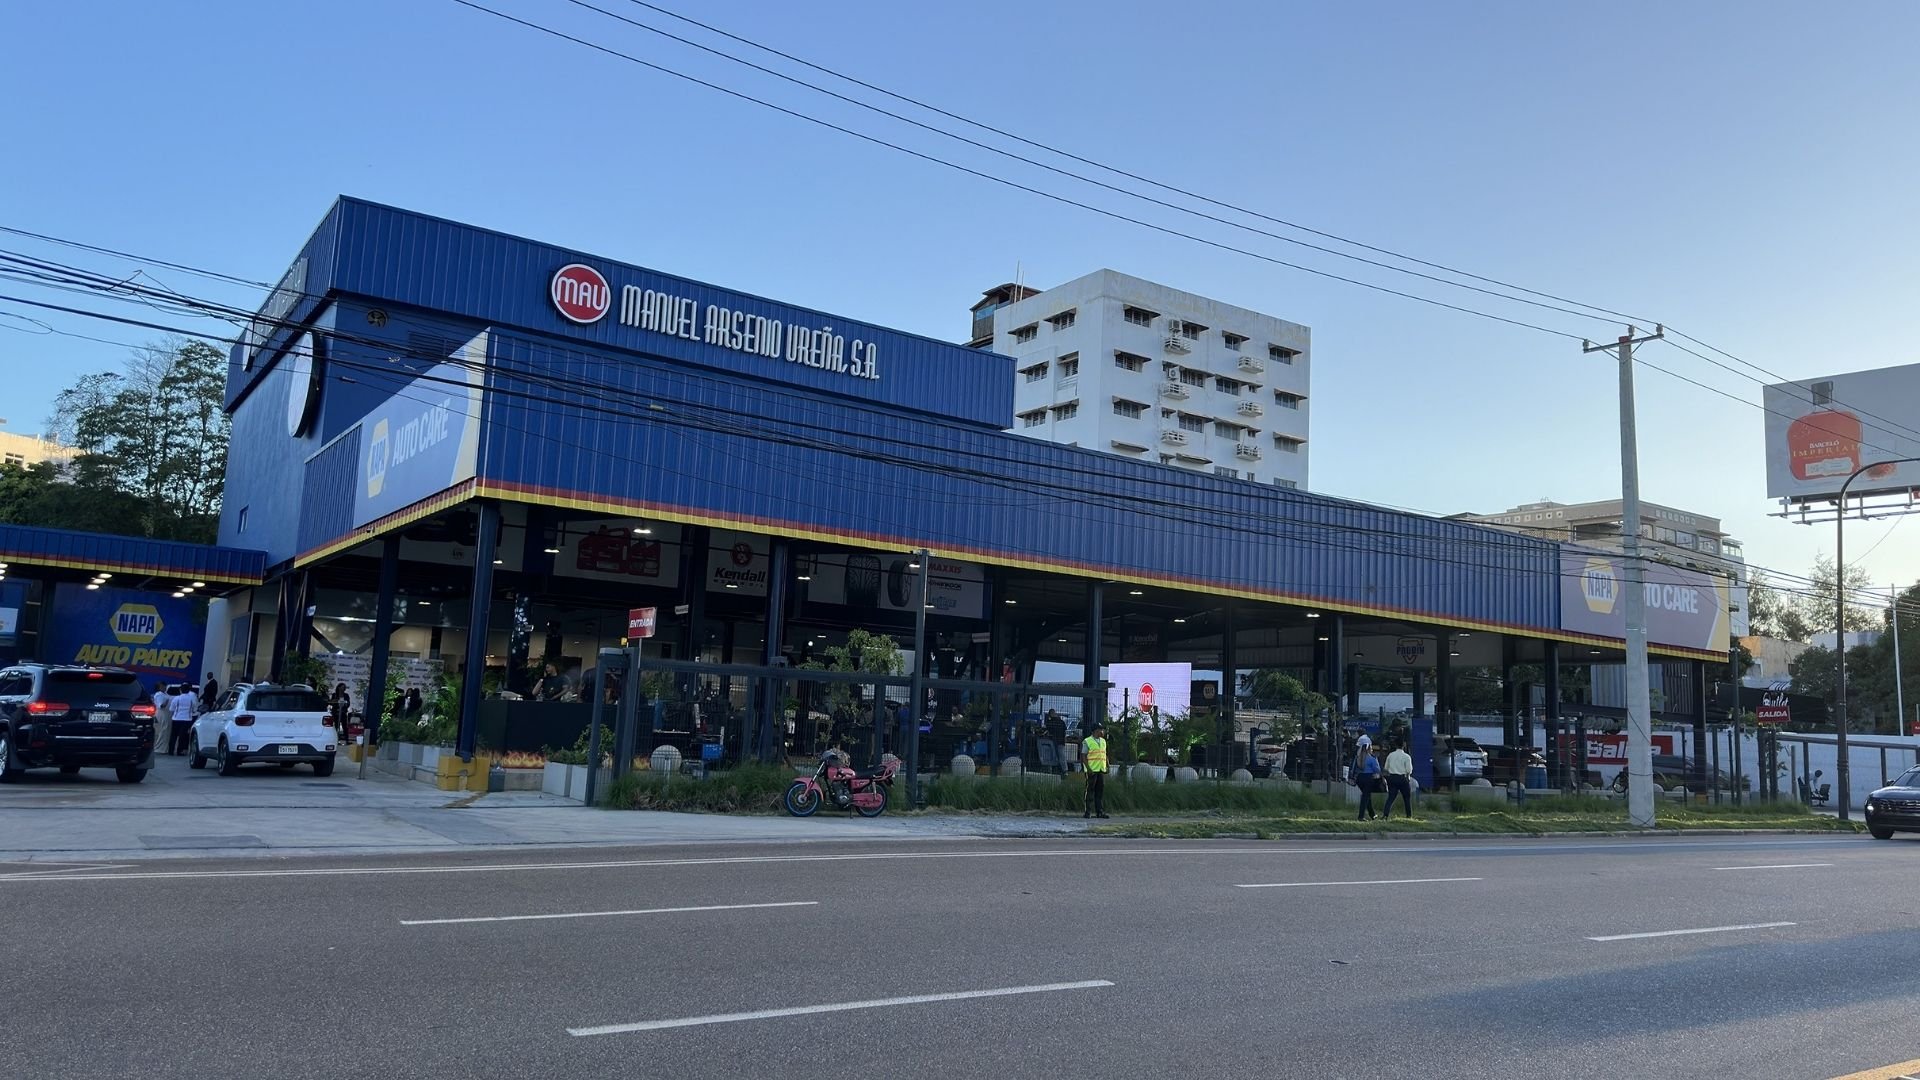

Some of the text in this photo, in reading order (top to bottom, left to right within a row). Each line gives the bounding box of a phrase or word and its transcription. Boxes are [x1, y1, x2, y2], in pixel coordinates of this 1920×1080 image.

[556, 276, 606, 310] MAU
[620, 284, 880, 379] MANUEL ARSENIO UREÑA, S.A.
[391, 398, 451, 468] AUTO CARE
[1793, 444, 1857, 457] IMPERIAL
[714, 567, 767, 583] Kendall
[1587, 571, 1613, 599] NAPA
[1644, 582, 1698, 614] TO CARE
[117, 613, 155, 634] NAPA
[630, 618, 653, 628] ENTRADA
[74, 644, 192, 669] AUTO PARTS
[1758, 710, 1788, 718] SALIDA
